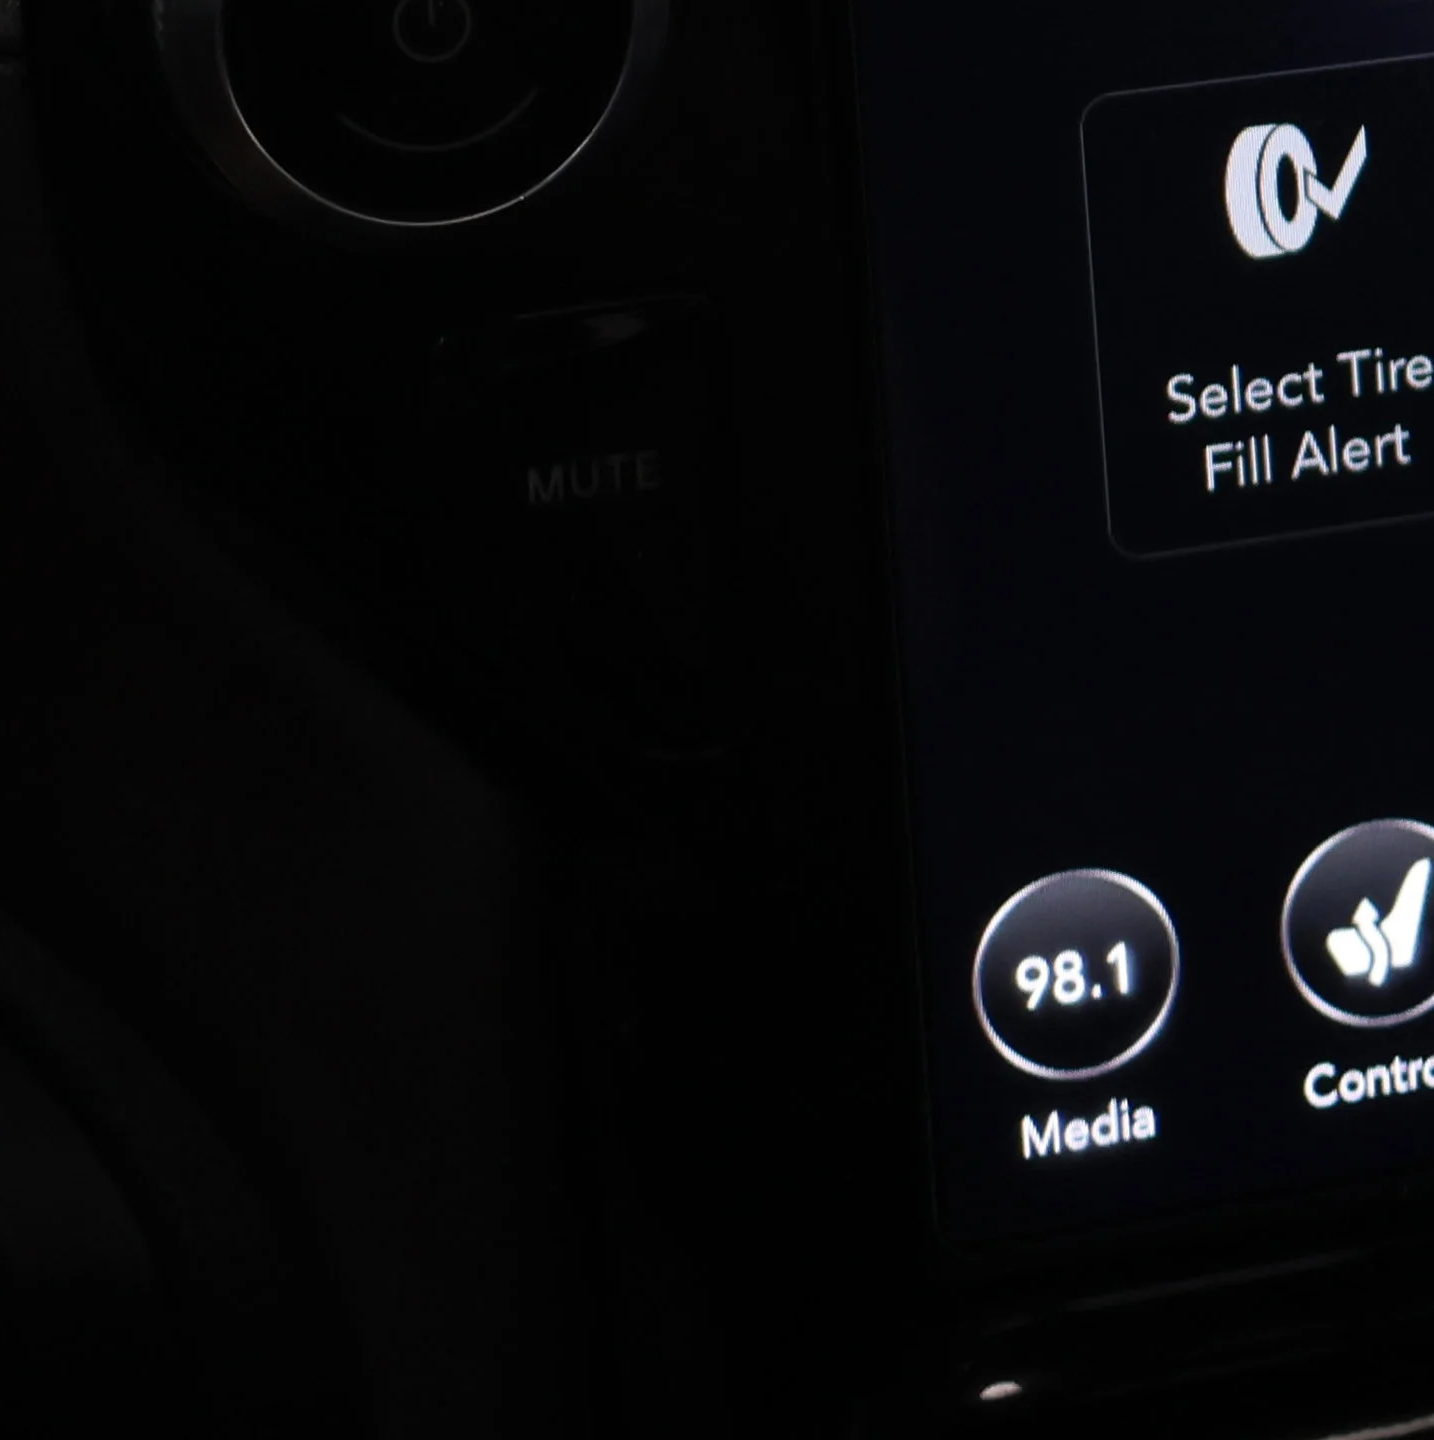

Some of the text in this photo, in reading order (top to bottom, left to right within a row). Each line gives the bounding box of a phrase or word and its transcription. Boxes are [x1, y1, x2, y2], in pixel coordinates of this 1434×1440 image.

[1166, 347, 1434, 423] Select Tire
[526, 450, 662, 507] MUTE
[1205, 424, 1412, 492] Fill Alert
[1015, 941, 1134, 1011] 98.1
[1021, 1098, 1157, 1160] Media
